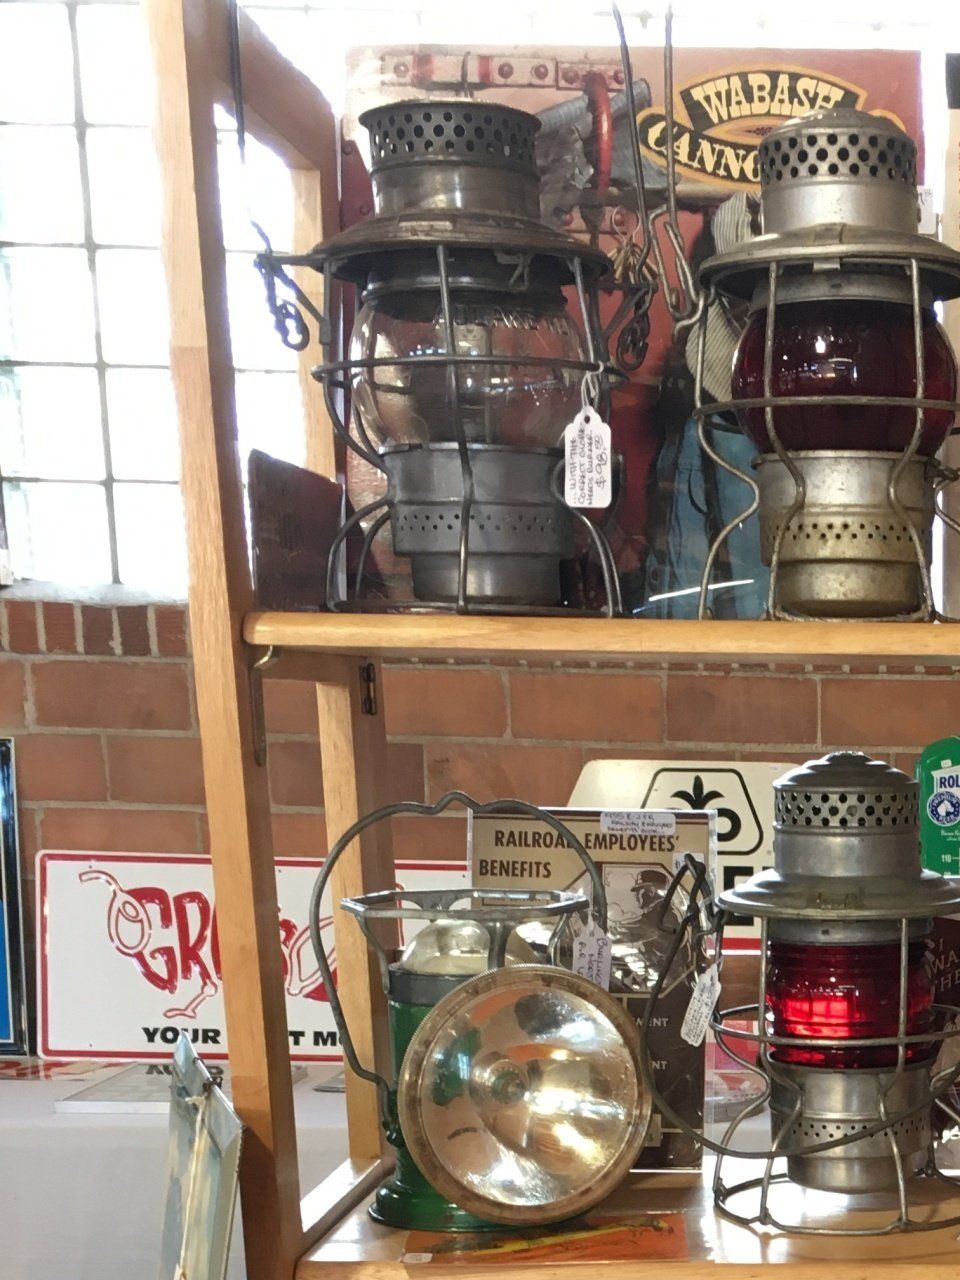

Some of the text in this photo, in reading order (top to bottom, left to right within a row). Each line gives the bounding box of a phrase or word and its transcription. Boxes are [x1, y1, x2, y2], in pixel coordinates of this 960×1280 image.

[690, 73, 845, 125] WABASH
[494, 830, 680, 852] RAILROA EMPLOYEES'
[479, 859, 552, 879] BENEFITS
